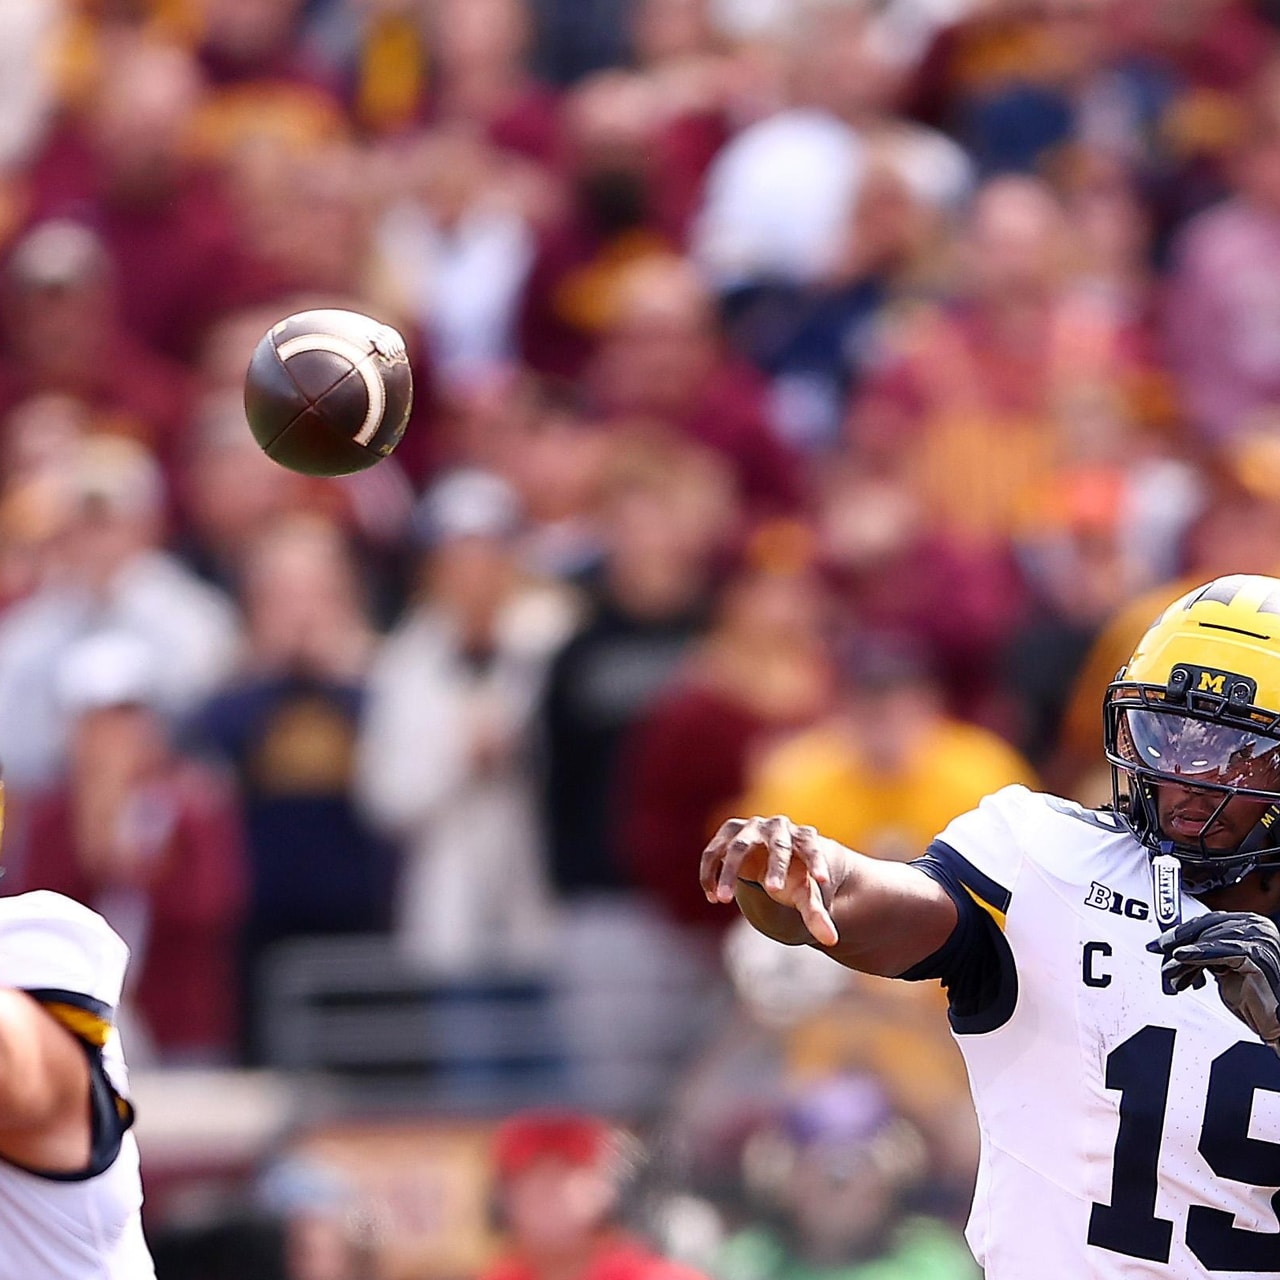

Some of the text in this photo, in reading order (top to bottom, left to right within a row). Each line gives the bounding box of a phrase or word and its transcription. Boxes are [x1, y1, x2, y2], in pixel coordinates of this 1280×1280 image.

[1197, 671, 1226, 695] M
[1159, 865, 1174, 916] BATTLE
[1082, 941, 1113, 988] C
